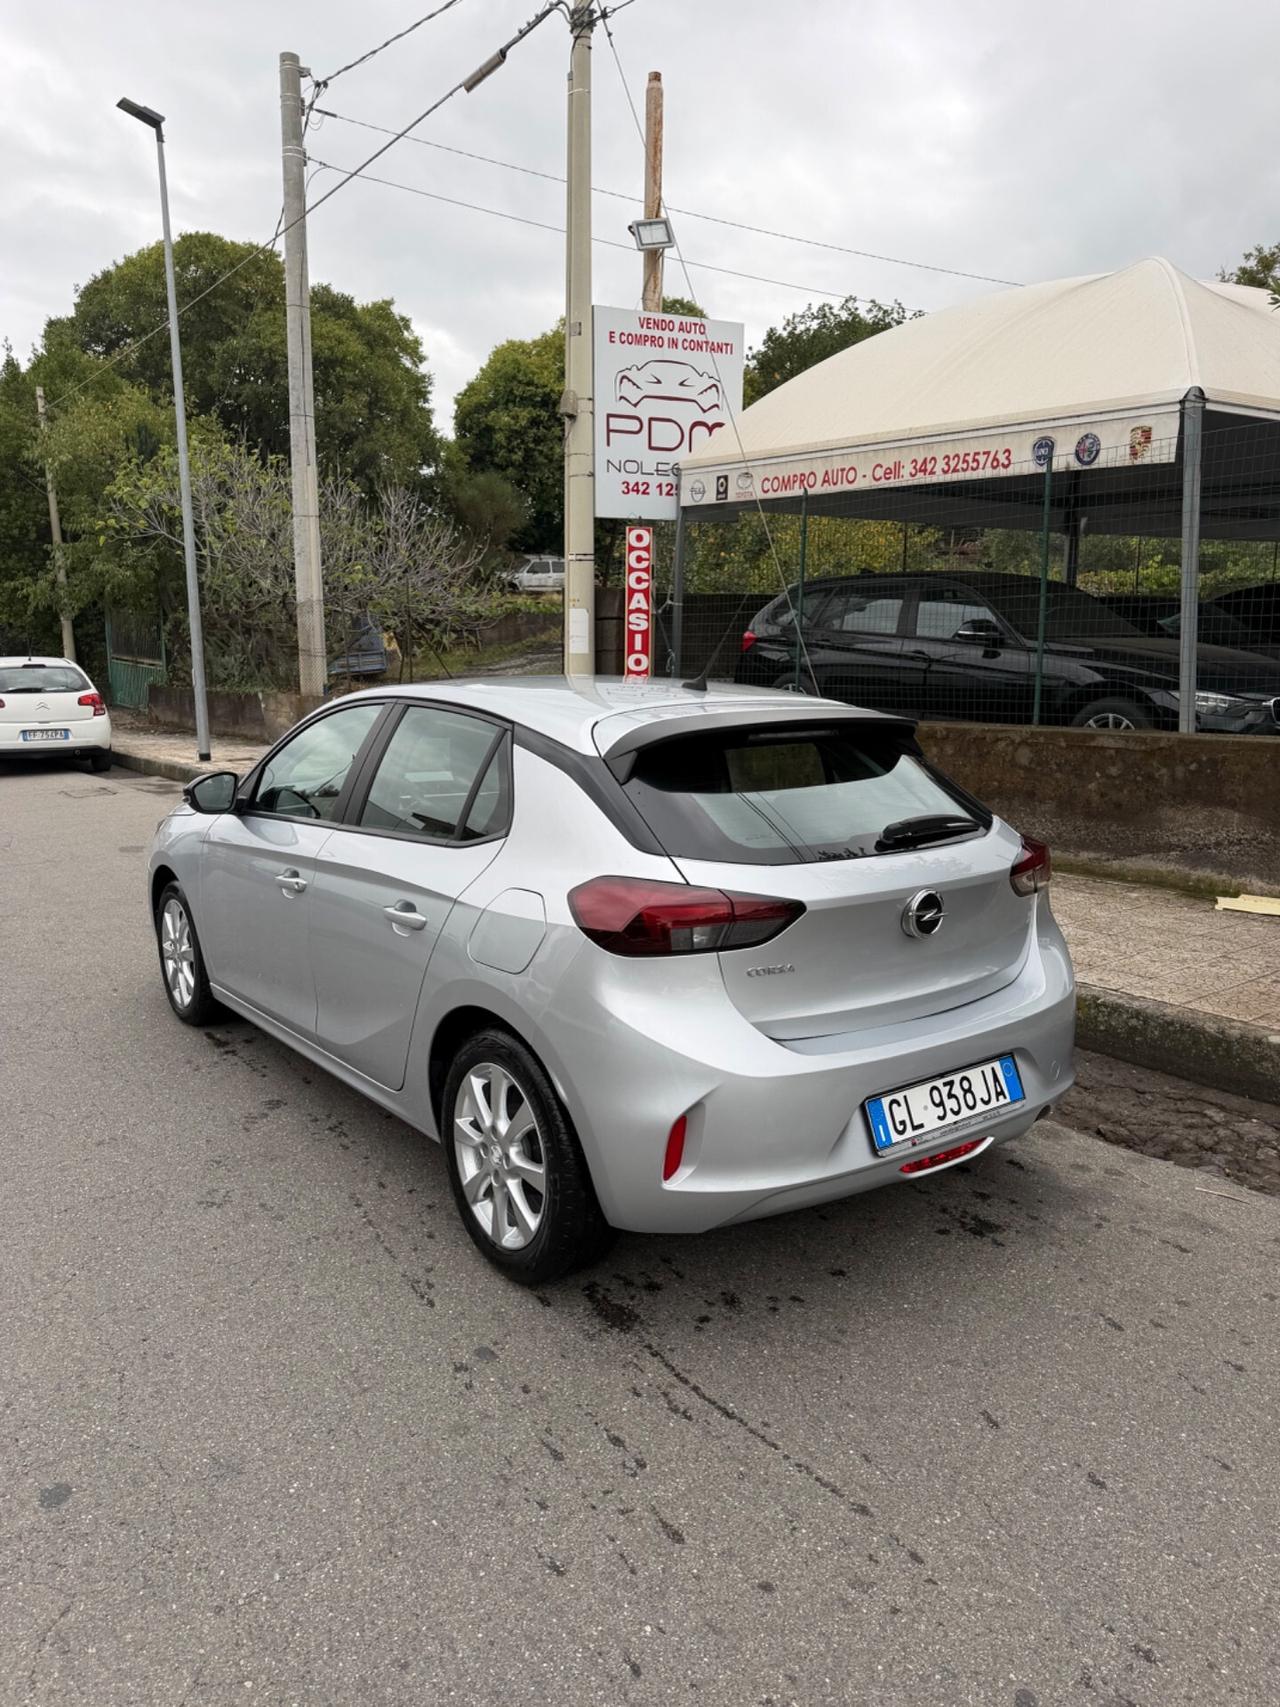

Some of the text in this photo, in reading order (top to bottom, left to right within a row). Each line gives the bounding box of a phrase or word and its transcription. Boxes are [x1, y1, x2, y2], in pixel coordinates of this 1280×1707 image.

[638, 316, 706, 335] VENDO AUTO
[608, 331, 734, 355] E COMPRO IN CONTANTI
[760, 472, 817, 494] COMPRO
[821, 466, 858, 488] AUTO
[872, 460, 905, 482] Cell:
[909, 456, 937, 479] 342
[941, 448, 1012, 475] 3255763
[621, 481, 650, 496] 342
[746, 963, 796, 978] CORSA
[888, 1095, 925, 1136] GL
[929, 1066, 1008, 1121] 938JA
